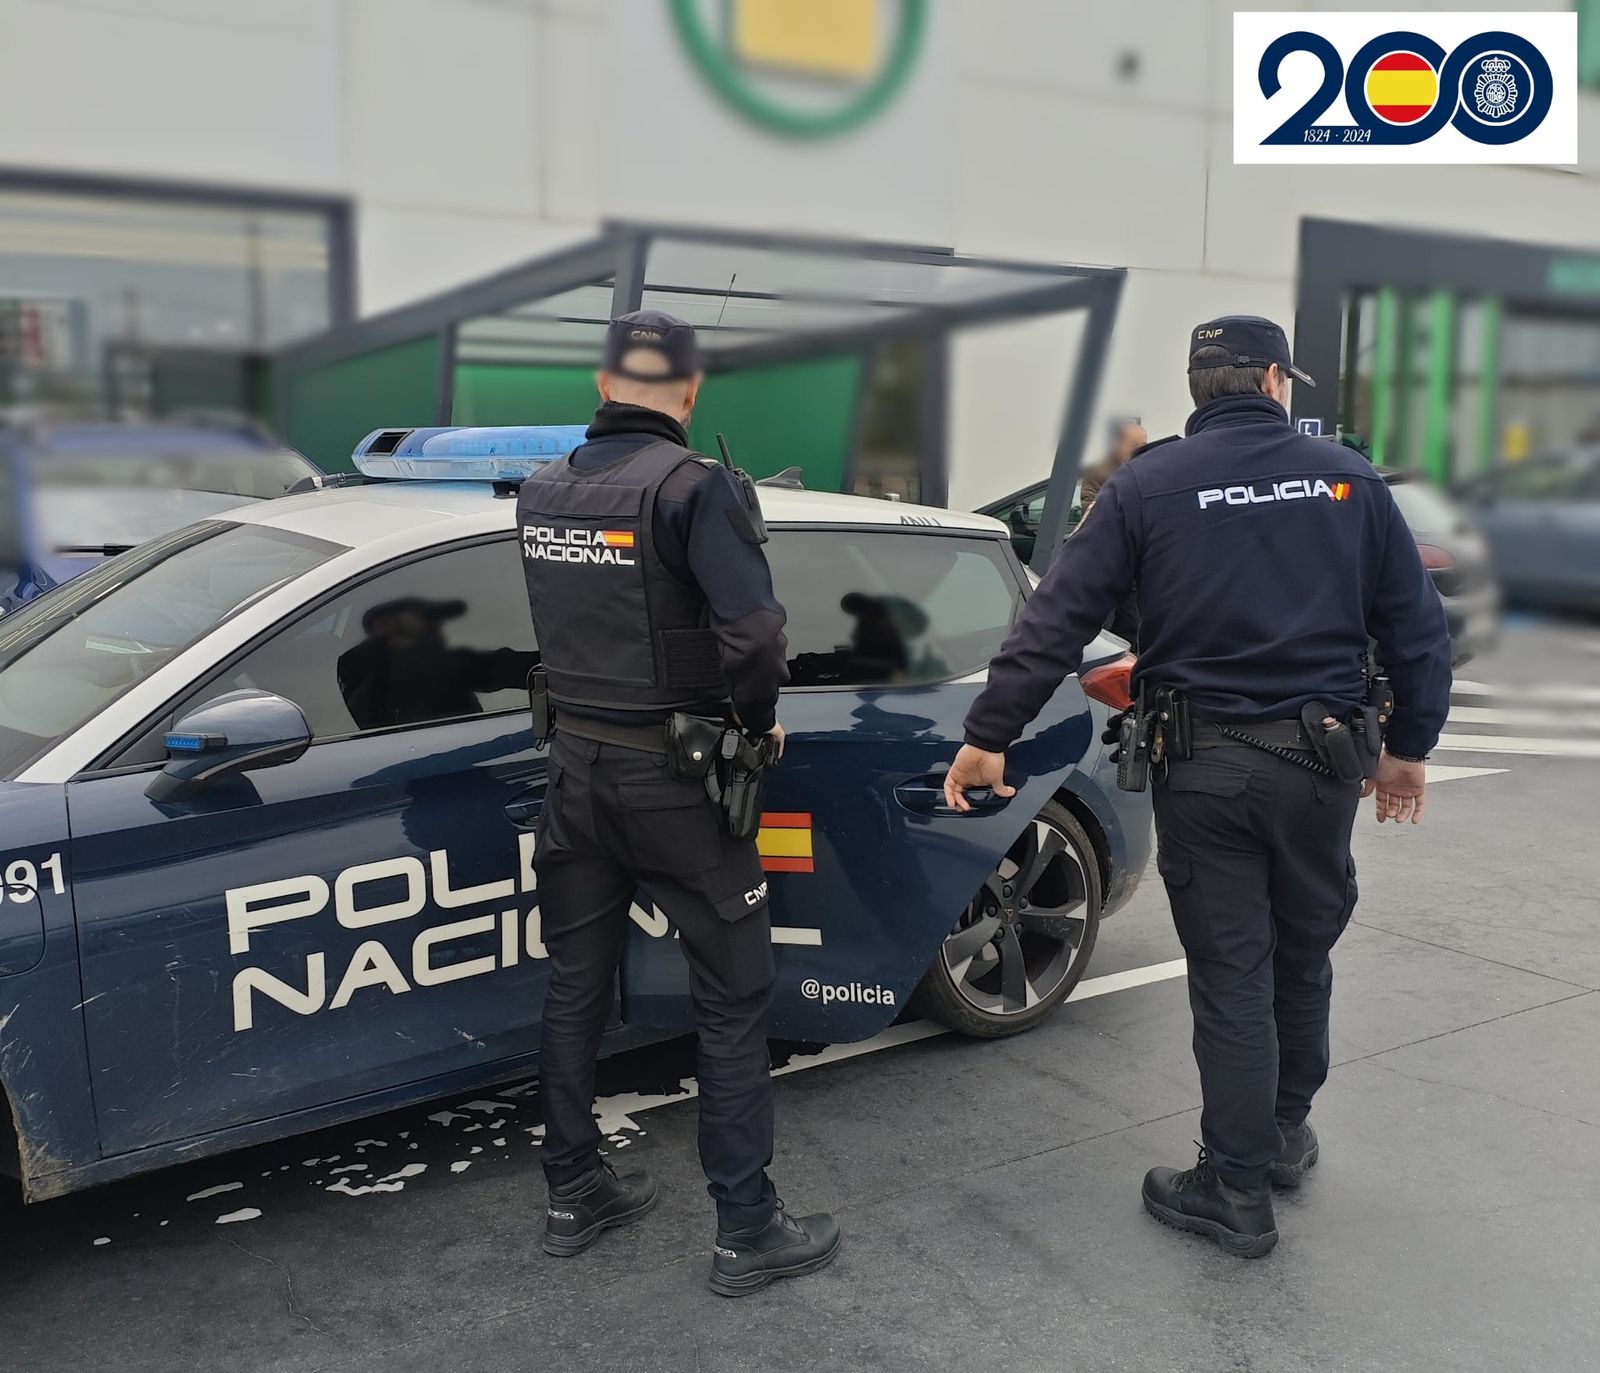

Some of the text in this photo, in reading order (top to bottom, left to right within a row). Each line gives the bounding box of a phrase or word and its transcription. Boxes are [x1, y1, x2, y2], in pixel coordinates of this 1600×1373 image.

[1198, 328, 1224, 339] CNP
[1198, 480, 1335, 509] POLICIA
[523, 526, 608, 546] POLICIA
[524, 543, 635, 566] NACIONAL
[0, 853, 65, 904] 91
[225, 832, 538, 955] POLI
[744, 881, 768, 906] CNP
[801, 979, 895, 1006] @policia
